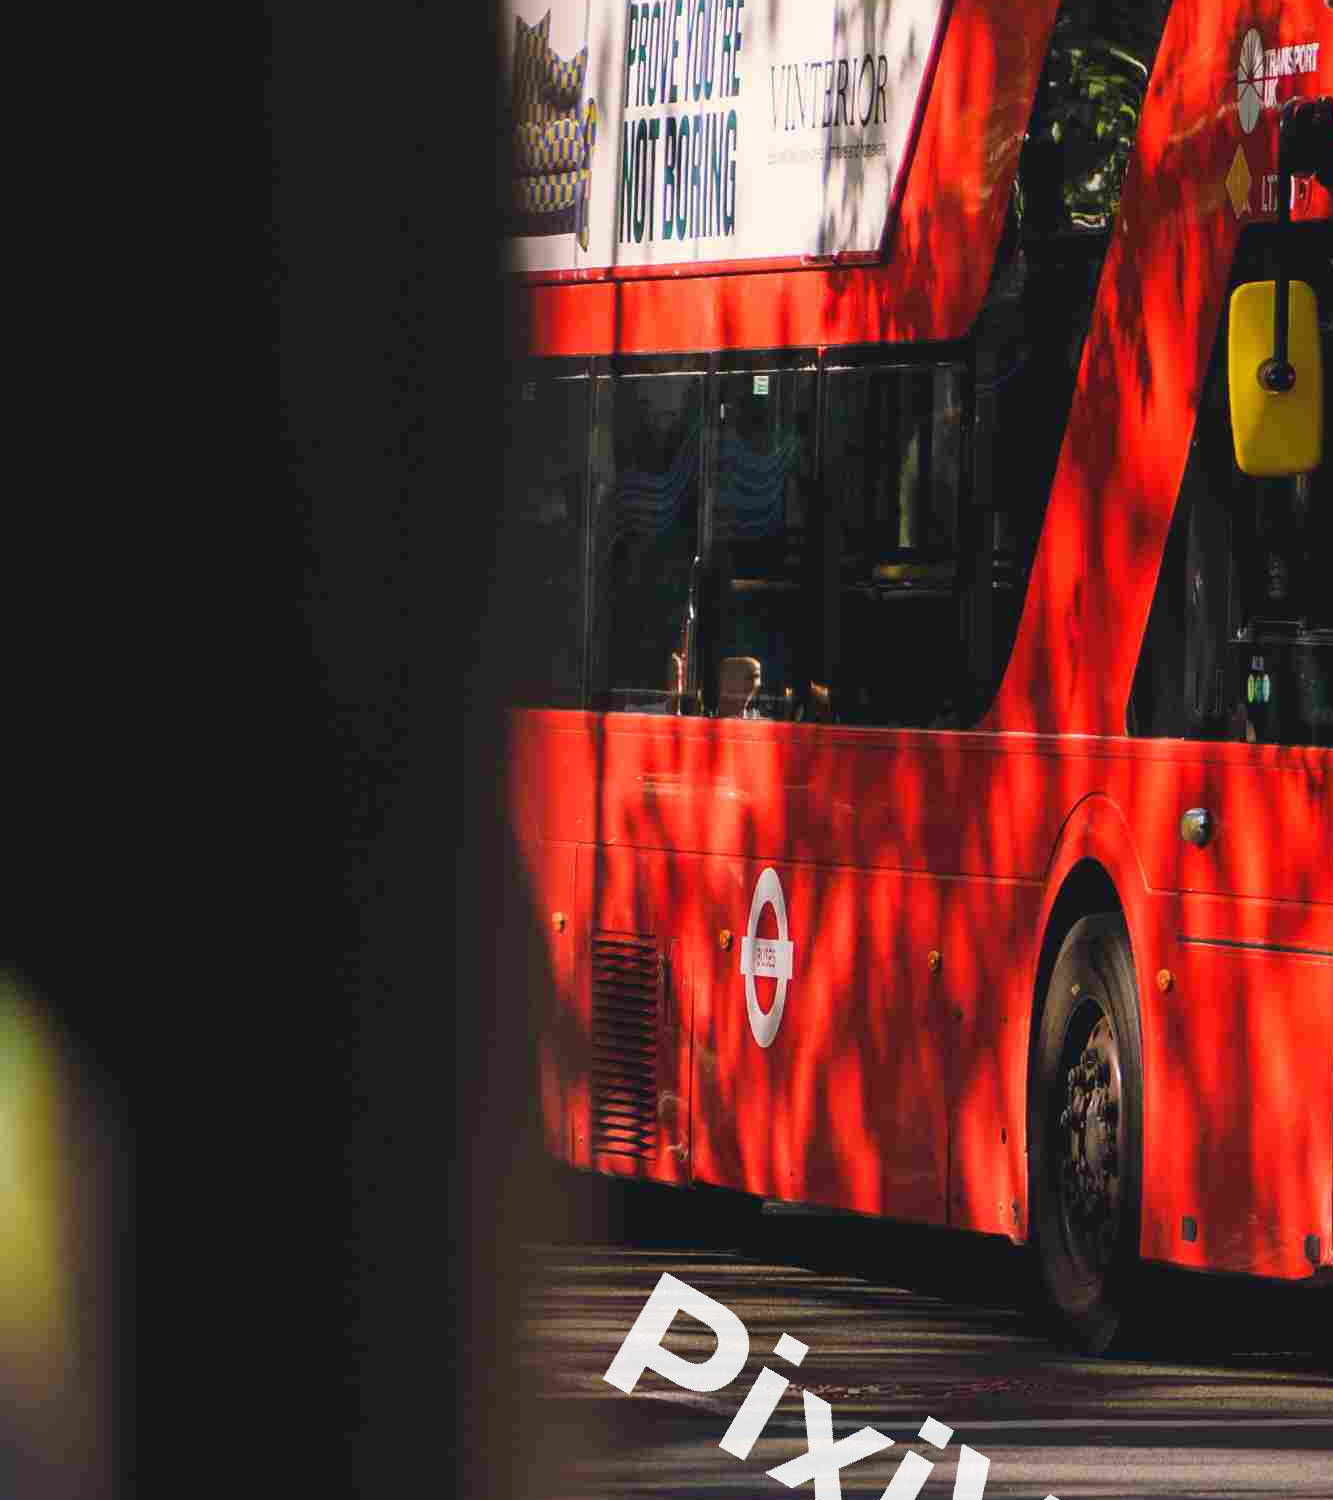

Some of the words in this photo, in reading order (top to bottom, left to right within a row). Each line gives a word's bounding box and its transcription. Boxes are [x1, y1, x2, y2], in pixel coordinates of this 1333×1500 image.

[624, 0, 683, 108] PROVE
[769, 53, 888, 131] VINTERIOR
[1264, 43, 1319, 76] TRANSPORT
[1264, 79, 1279, 107] UK
[619, 118, 660, 243] NOT
[662, 109, 737, 241] BORING
